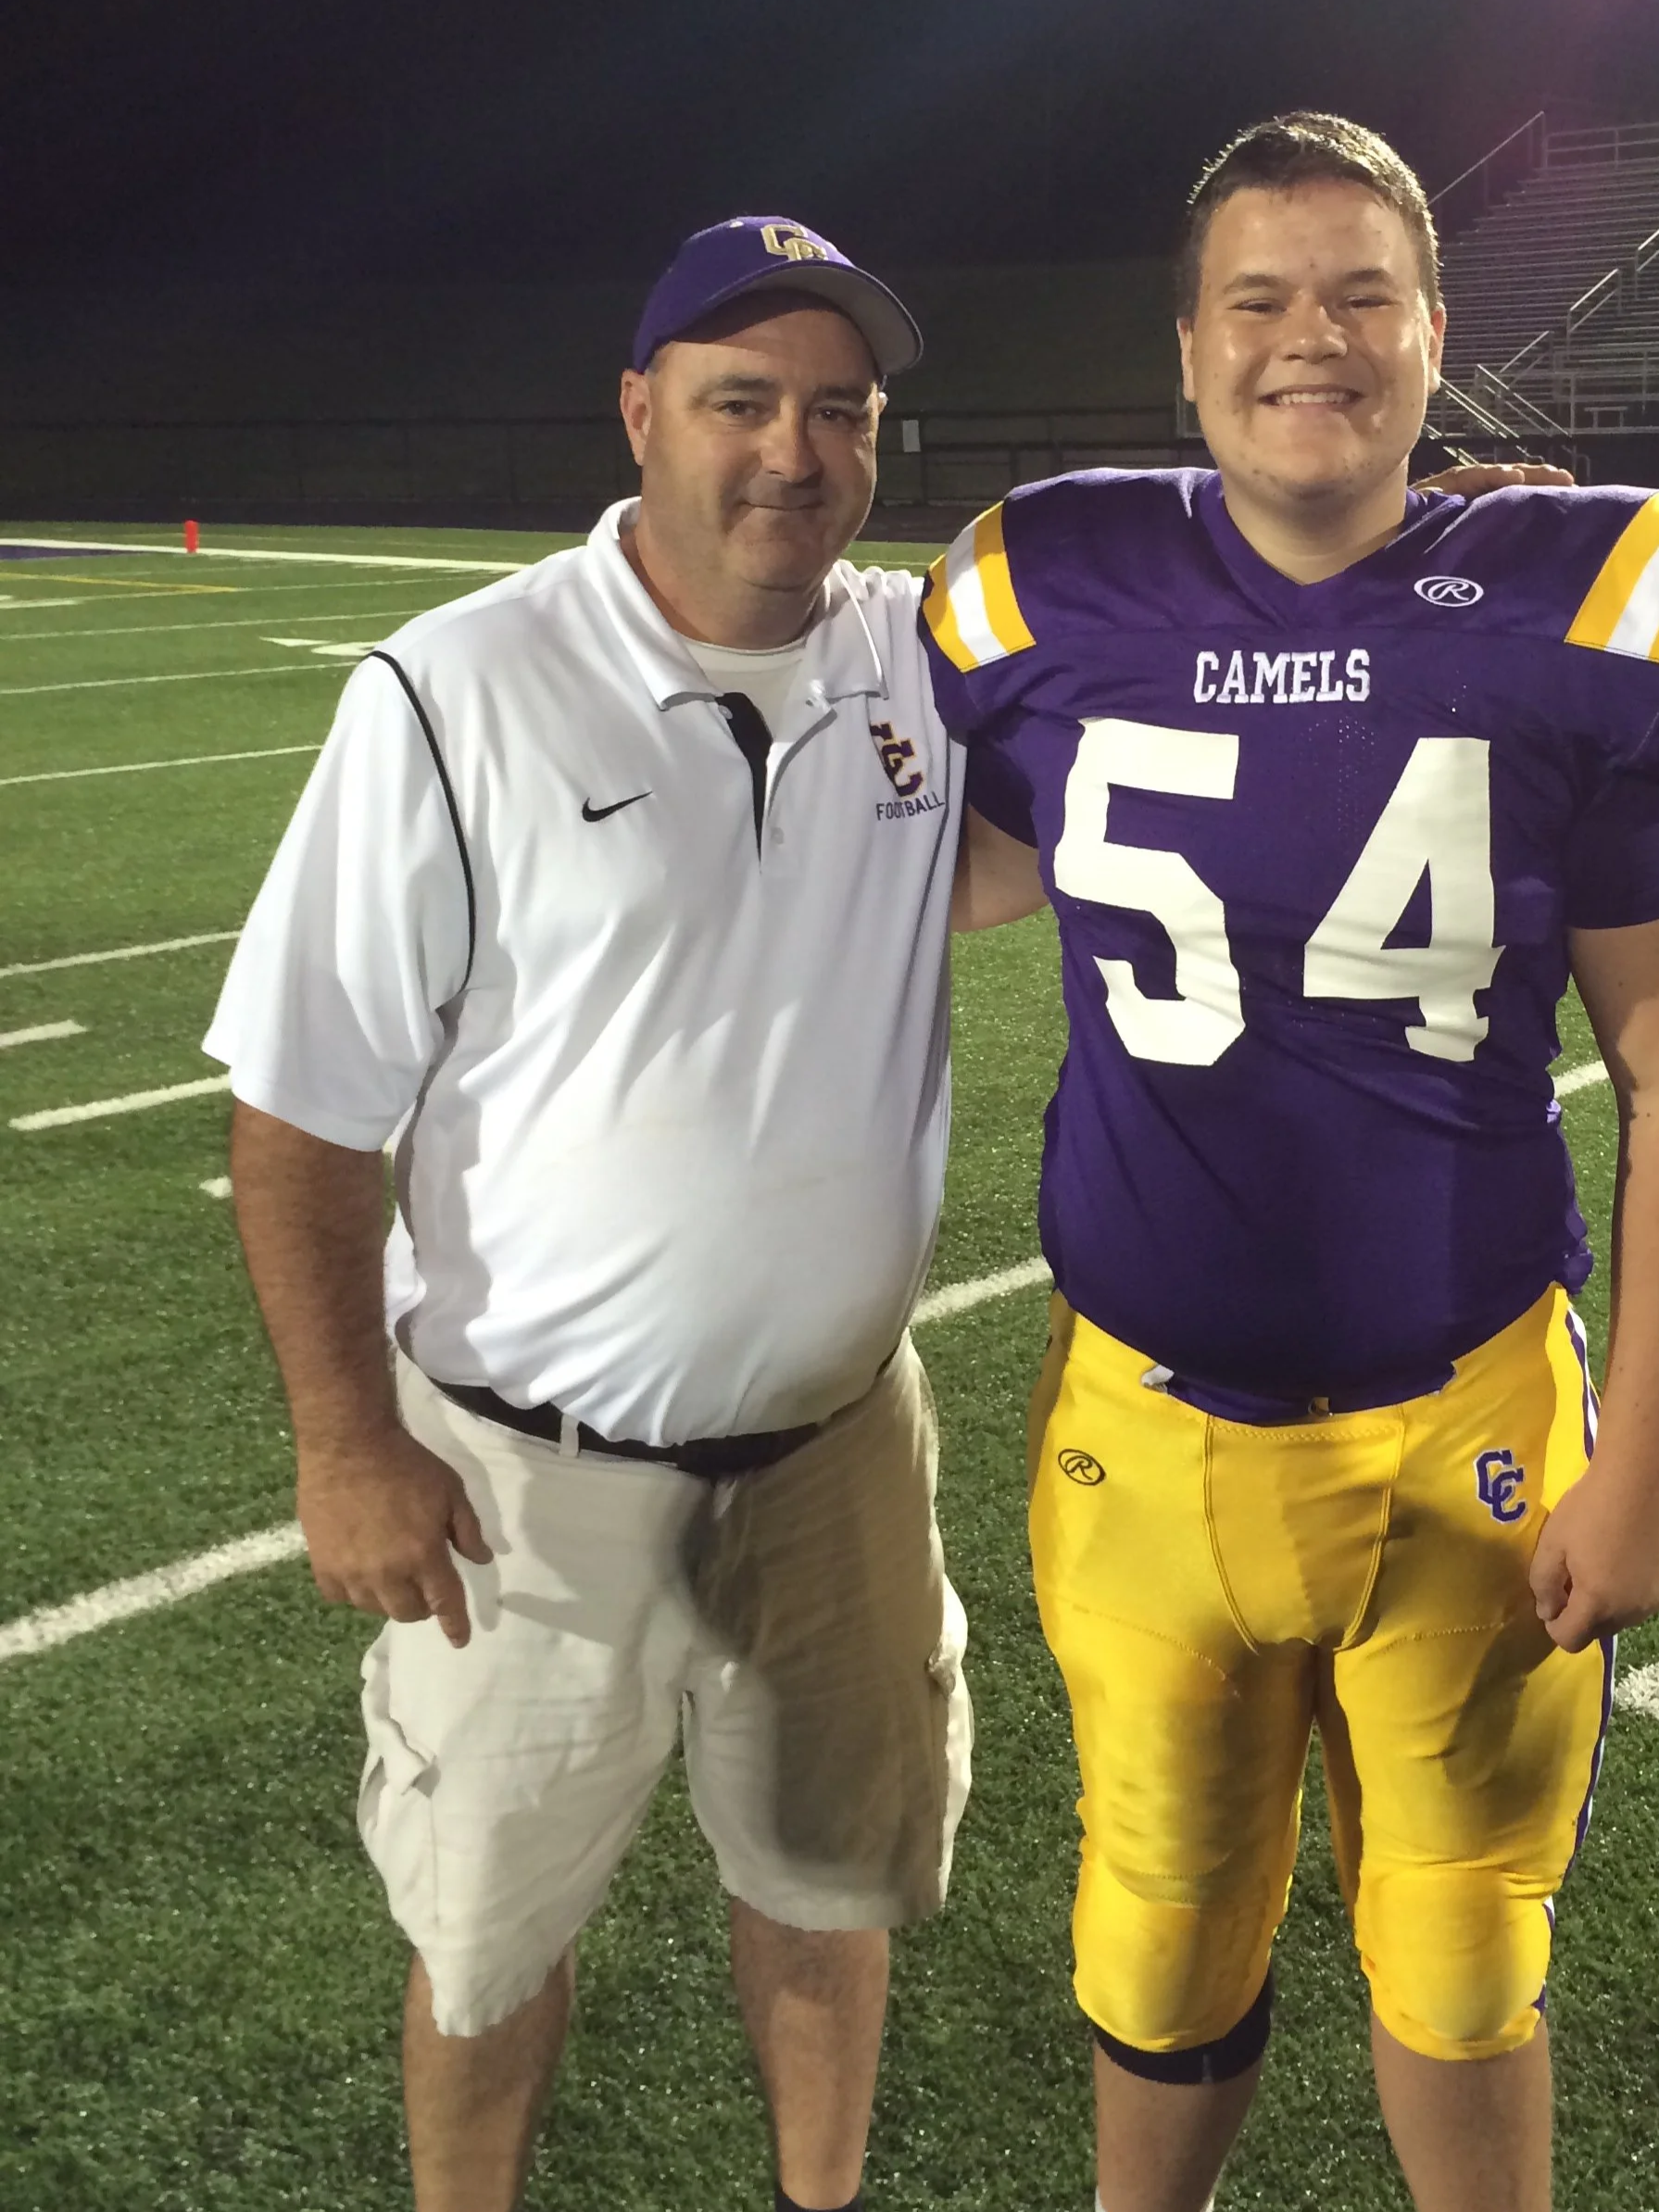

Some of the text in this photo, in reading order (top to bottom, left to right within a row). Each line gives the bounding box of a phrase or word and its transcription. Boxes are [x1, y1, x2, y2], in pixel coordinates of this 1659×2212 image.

[1193, 648, 1371, 704] CAMELS
[1053, 717, 1507, 1066] 54
[1473, 1449, 1527, 1524] CC
